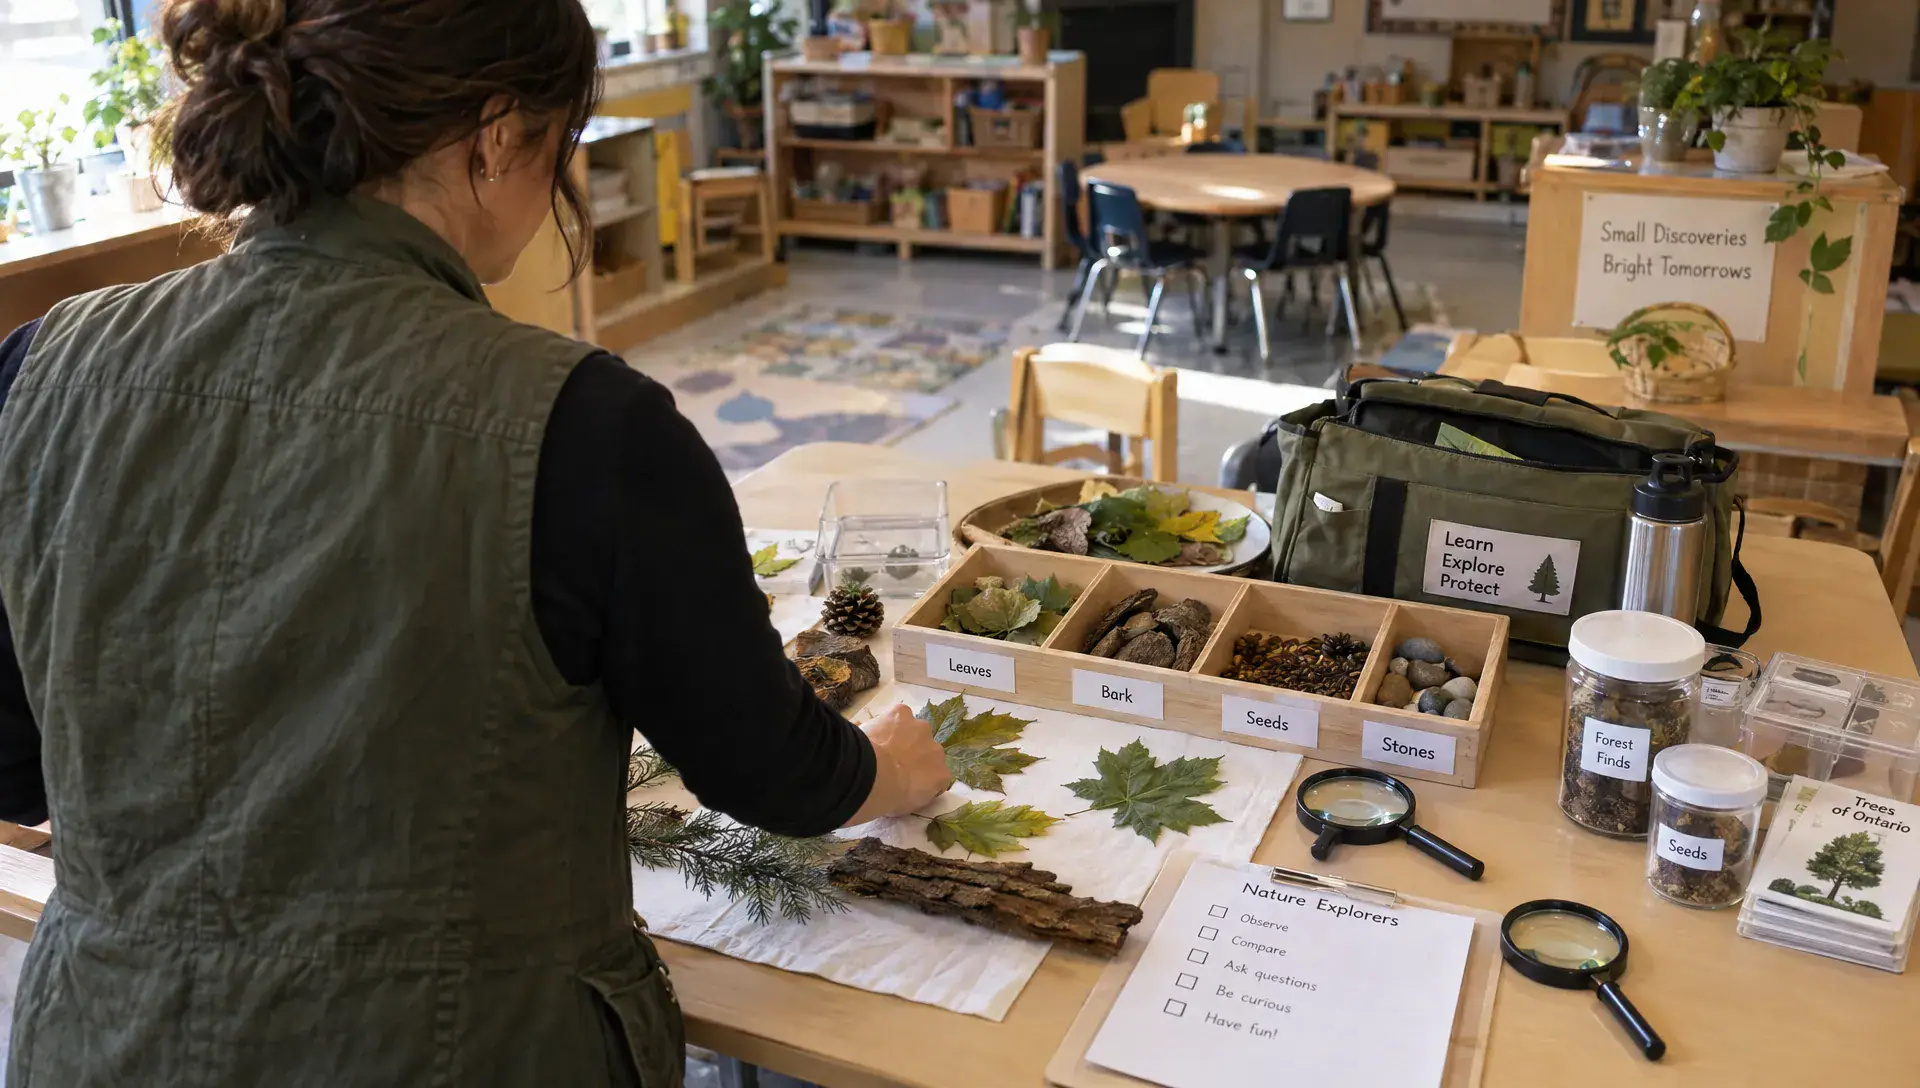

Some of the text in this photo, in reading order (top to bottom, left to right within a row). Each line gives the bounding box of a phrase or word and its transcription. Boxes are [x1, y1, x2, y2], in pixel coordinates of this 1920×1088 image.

[1600, 220, 1748, 247] Small Discoveries
[1603, 253, 1752, 282] Bright Tomorrows
[1445, 531, 1494, 552] Learn
[1442, 553, 1505, 576] Explore
[1440, 573, 1500, 596] Protect
[949, 658, 992, 678] Leaves
[1102, 685, 1133, 703] Bark
[1246, 710, 1289, 731] Seeds
[1382, 736, 1435, 760] Stones
[1595, 731, 1634, 751] Forest
[1597, 751, 1631, 769] Finds
[1855, 796, 1896, 816] Trees
[1832, 806, 1911, 833] of Ontario
[1668, 838, 1708, 861] Seeds
[1242, 882, 1400, 927] Nature Explorers
[1240, 913, 1289, 932] Observe
[1231, 935, 1287, 957] Compare
[1223, 960, 1318, 992] Ask questions
[1215, 984, 1291, 1014] Be curious
[1204, 1011, 1278, 1040] Have fun!
